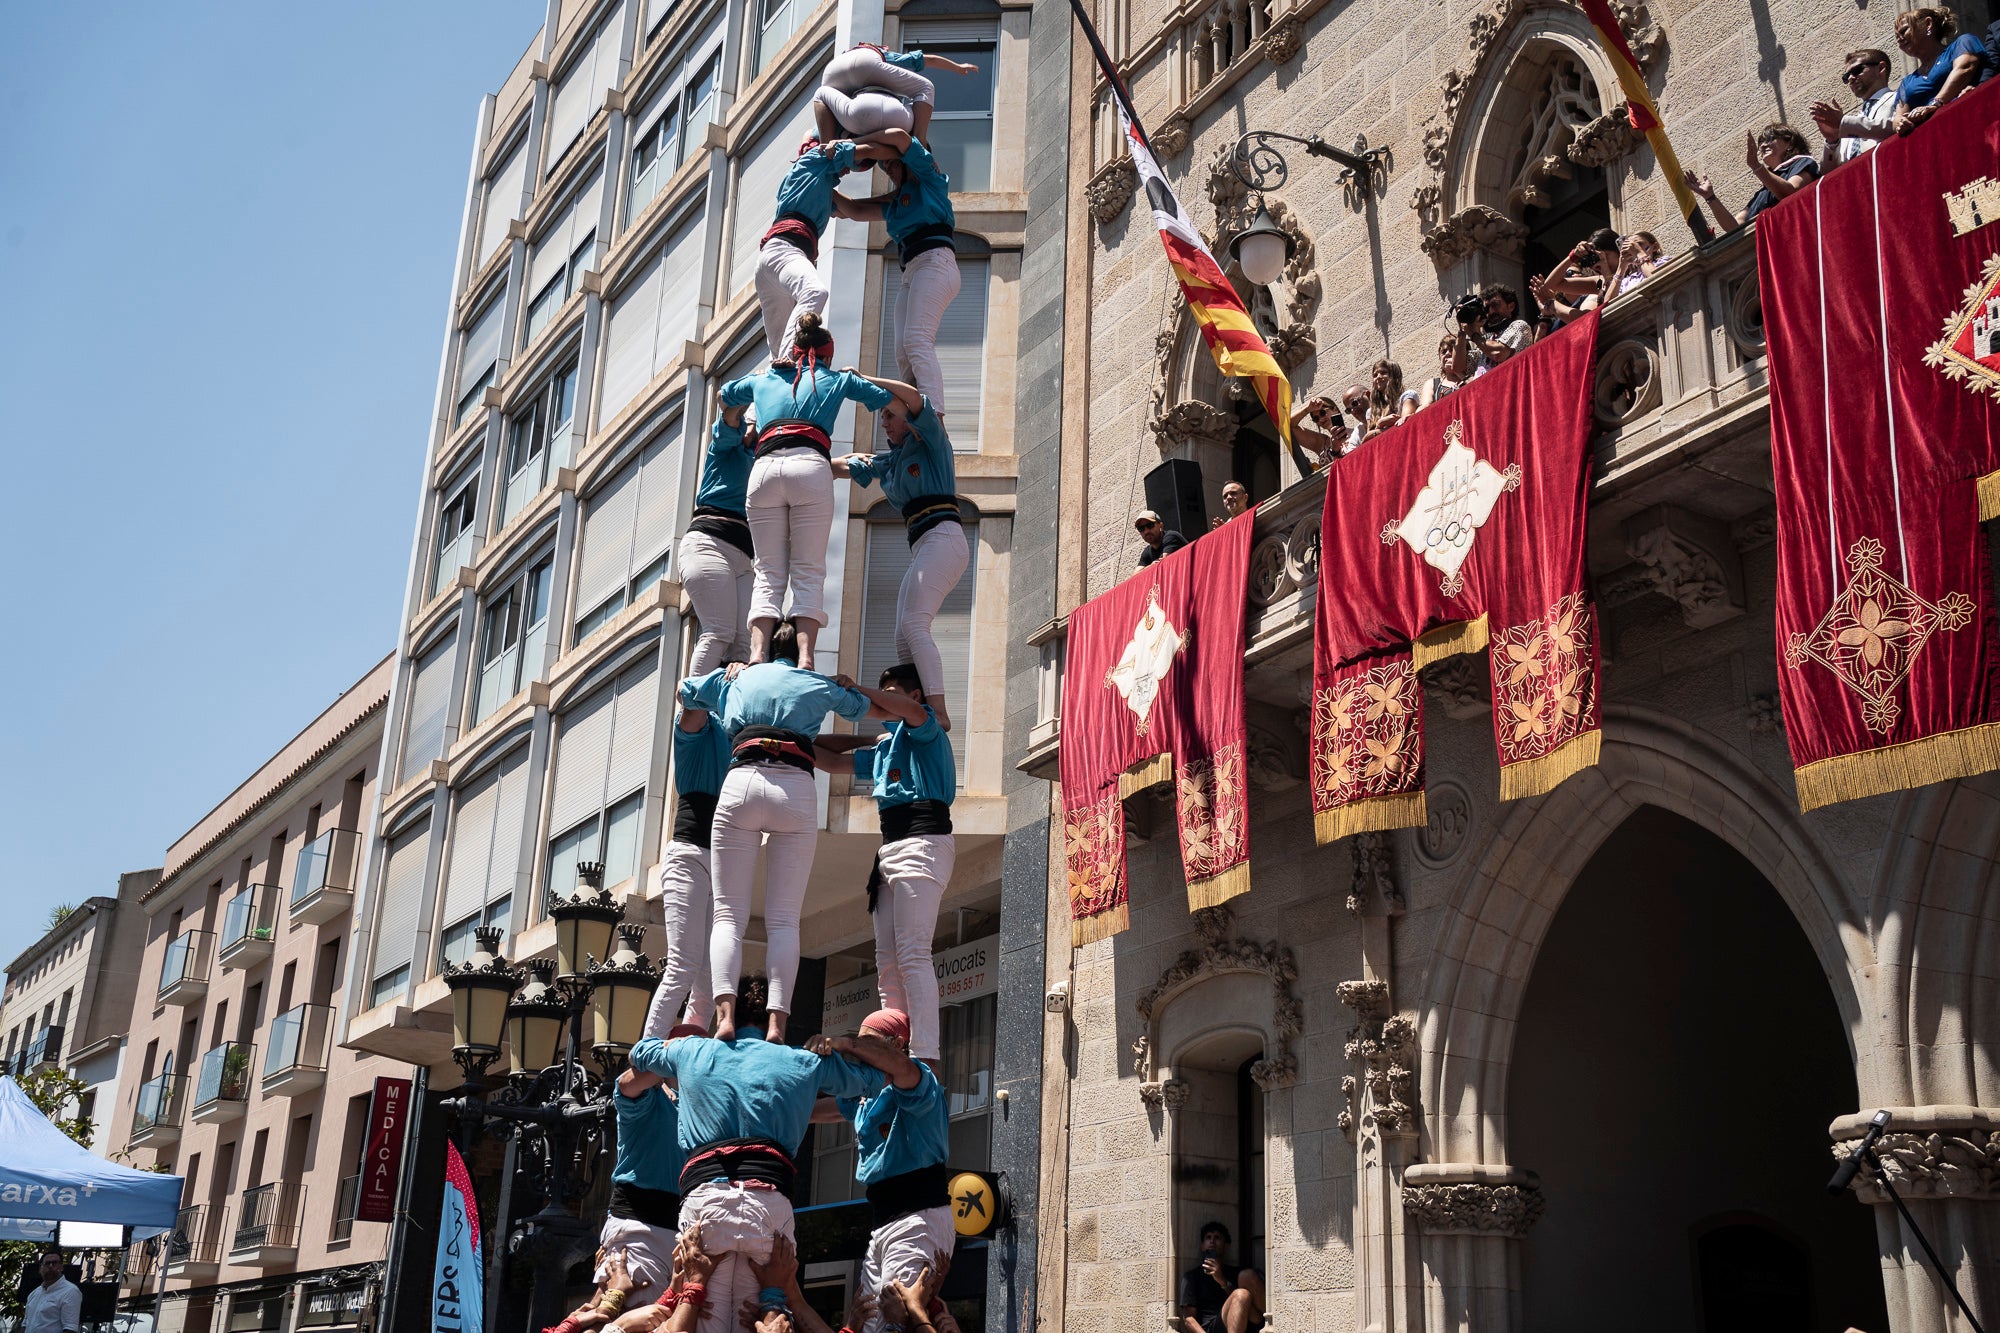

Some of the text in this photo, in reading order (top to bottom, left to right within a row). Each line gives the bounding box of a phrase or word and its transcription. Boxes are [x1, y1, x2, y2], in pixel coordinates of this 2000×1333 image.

[946, 980, 961, 996] 595
[963, 976, 973, 991] 55
[975, 972, 985, 987] 77
[375, 1085, 400, 1192] MEDICAL
